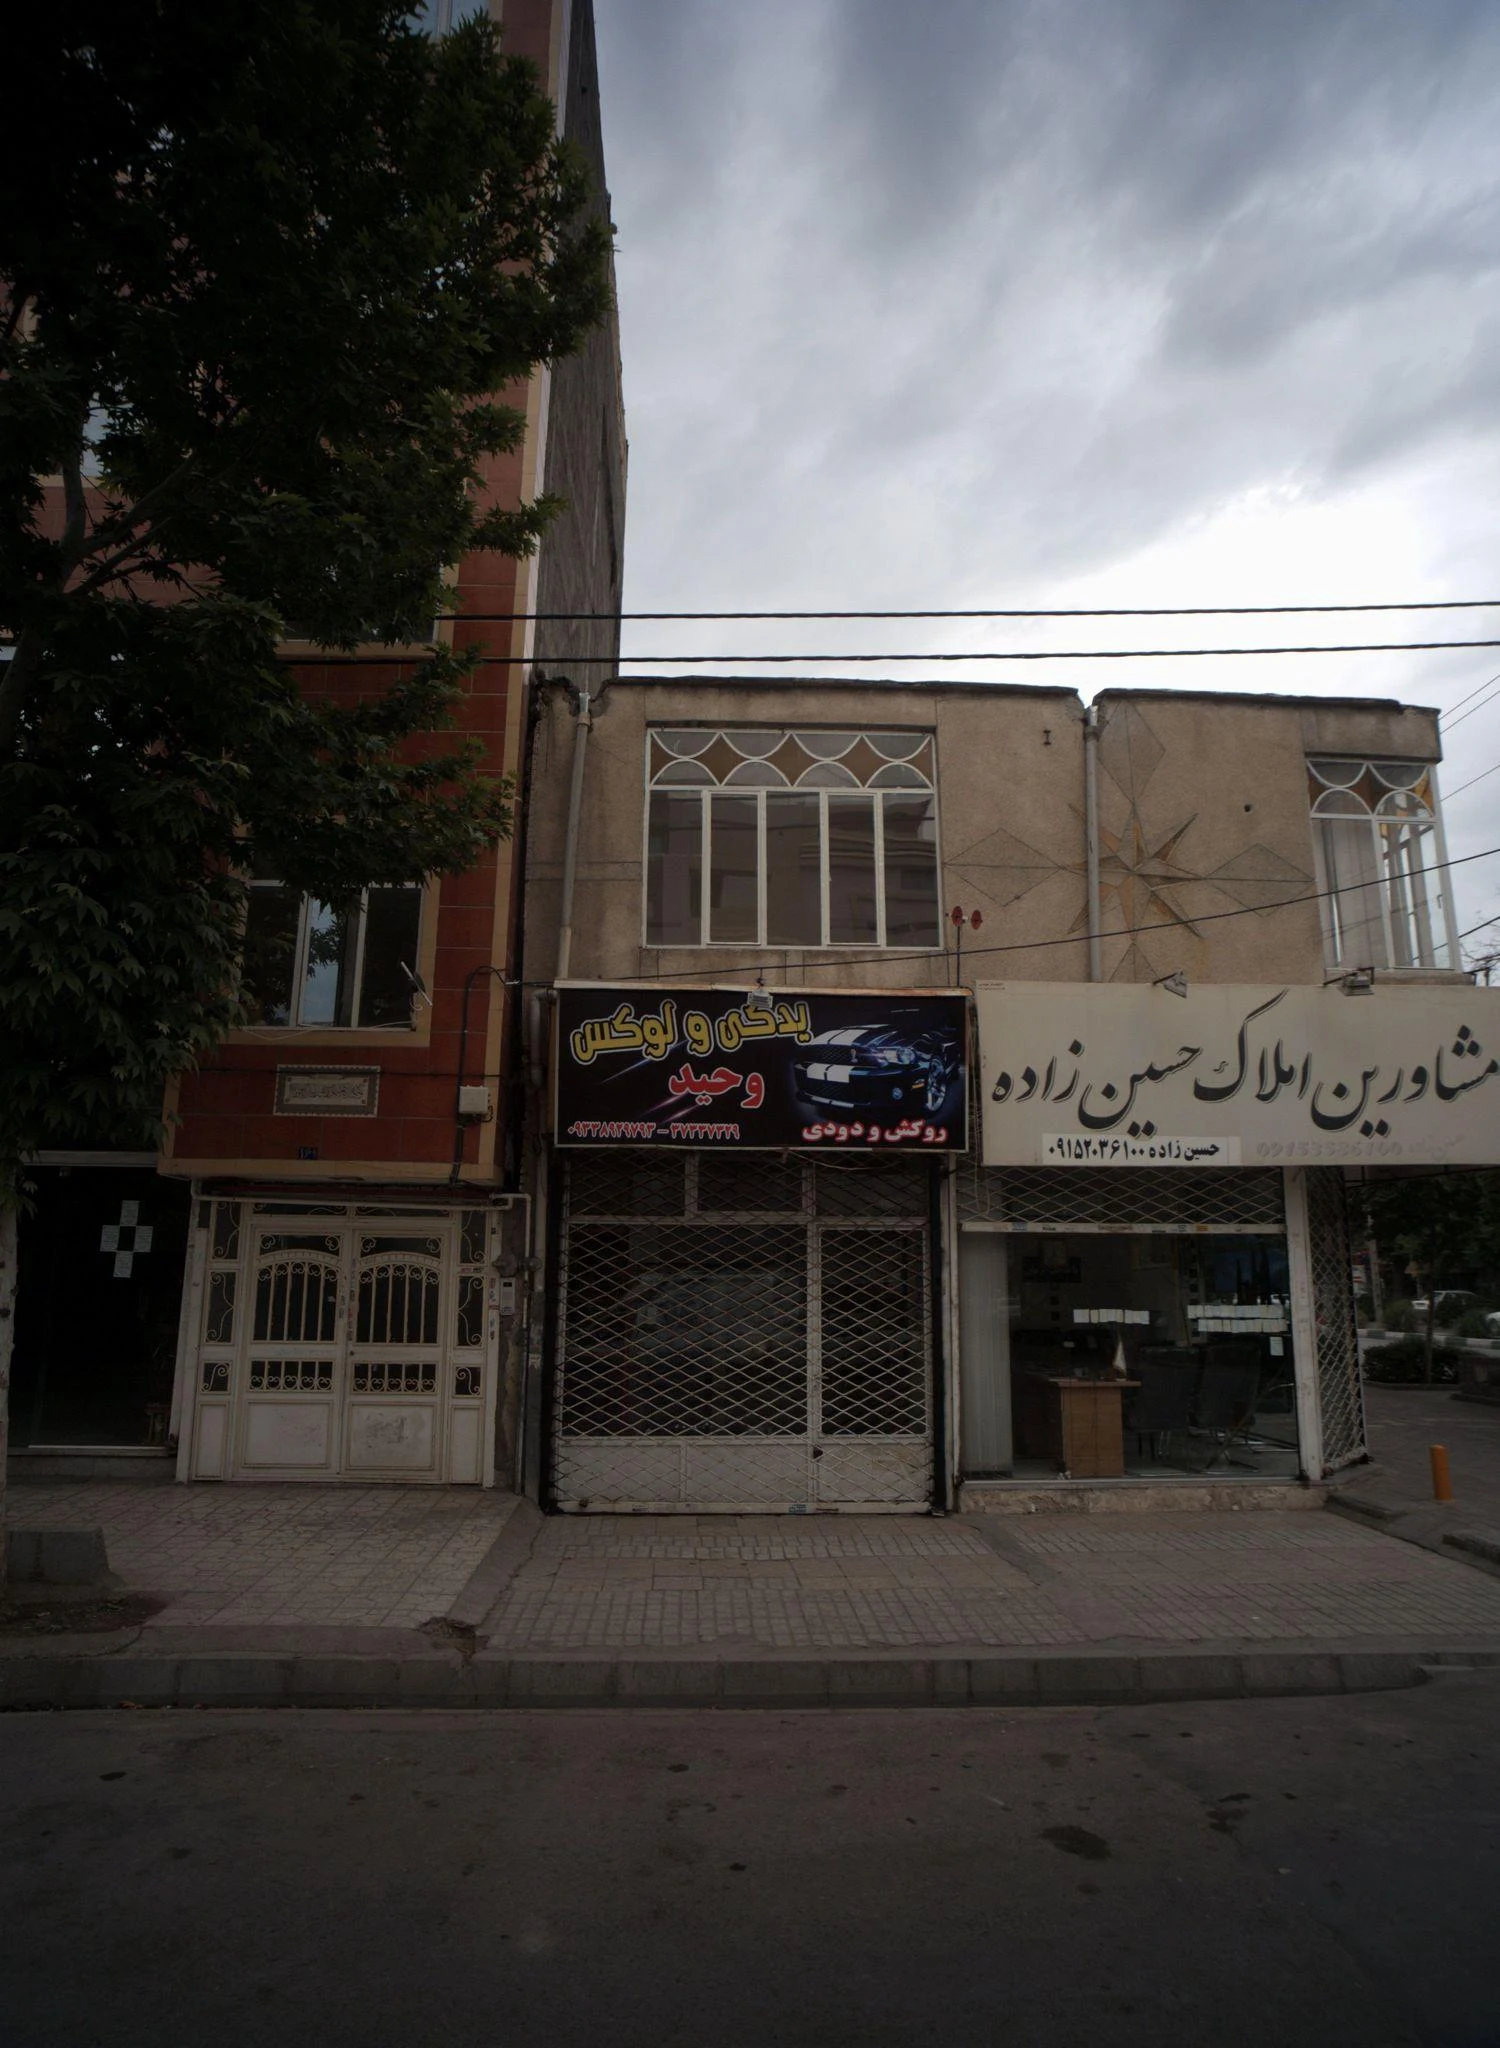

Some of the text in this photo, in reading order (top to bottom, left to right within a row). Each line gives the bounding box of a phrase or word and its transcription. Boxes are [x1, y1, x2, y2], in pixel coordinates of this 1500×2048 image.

[571, 1000, 811, 1065] یدکی و لوکس
[668, 1063, 766, 1109] وحید
[991, 1039, 1085, 1103] زاده
[1078, 1044, 1202, 1138] حسین
[1311, 1024, 1500, 1139] مشاورین
[801, 1119, 948, 1142] روکش و دودی
[1048, 1138, 1220, 1161] حسین زاده ۰۹۱۵۲۰۳۶۱۰۰
